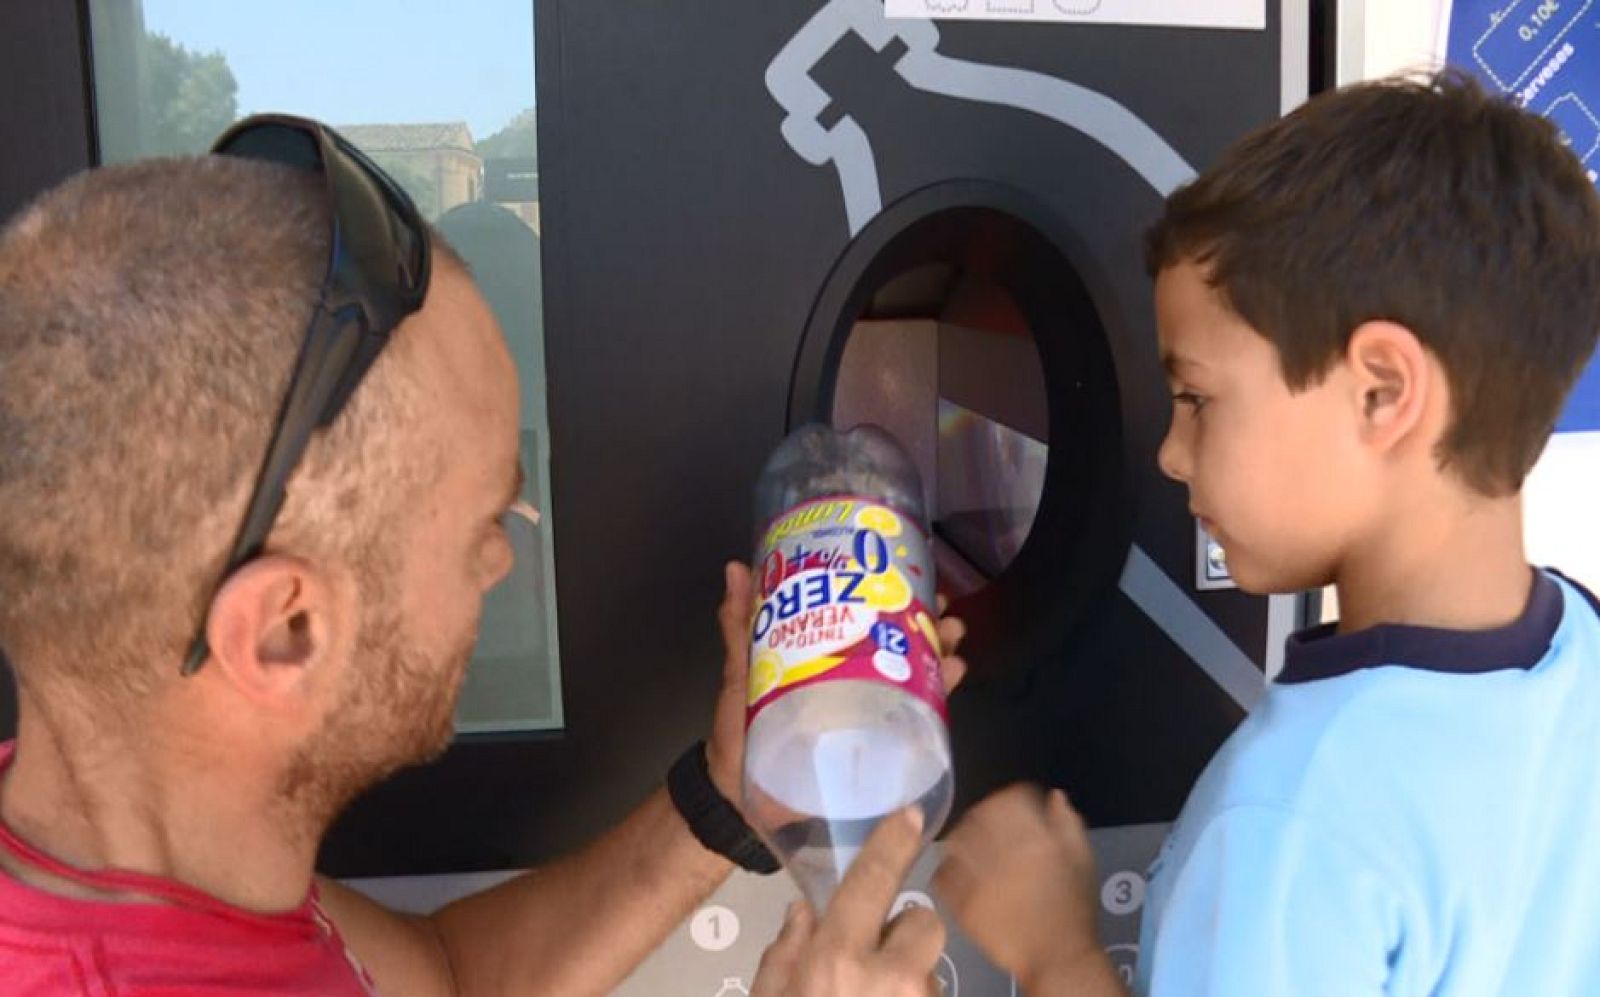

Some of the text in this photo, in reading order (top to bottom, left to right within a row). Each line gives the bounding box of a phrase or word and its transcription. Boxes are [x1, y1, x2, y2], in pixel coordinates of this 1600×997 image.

[753, 571, 866, 642] ZERO
[768, 605, 855, 649] VERANO
[798, 625, 844, 648] TINTO
[1115, 880, 1132, 904] 3
[708, 915, 720, 939] 1
